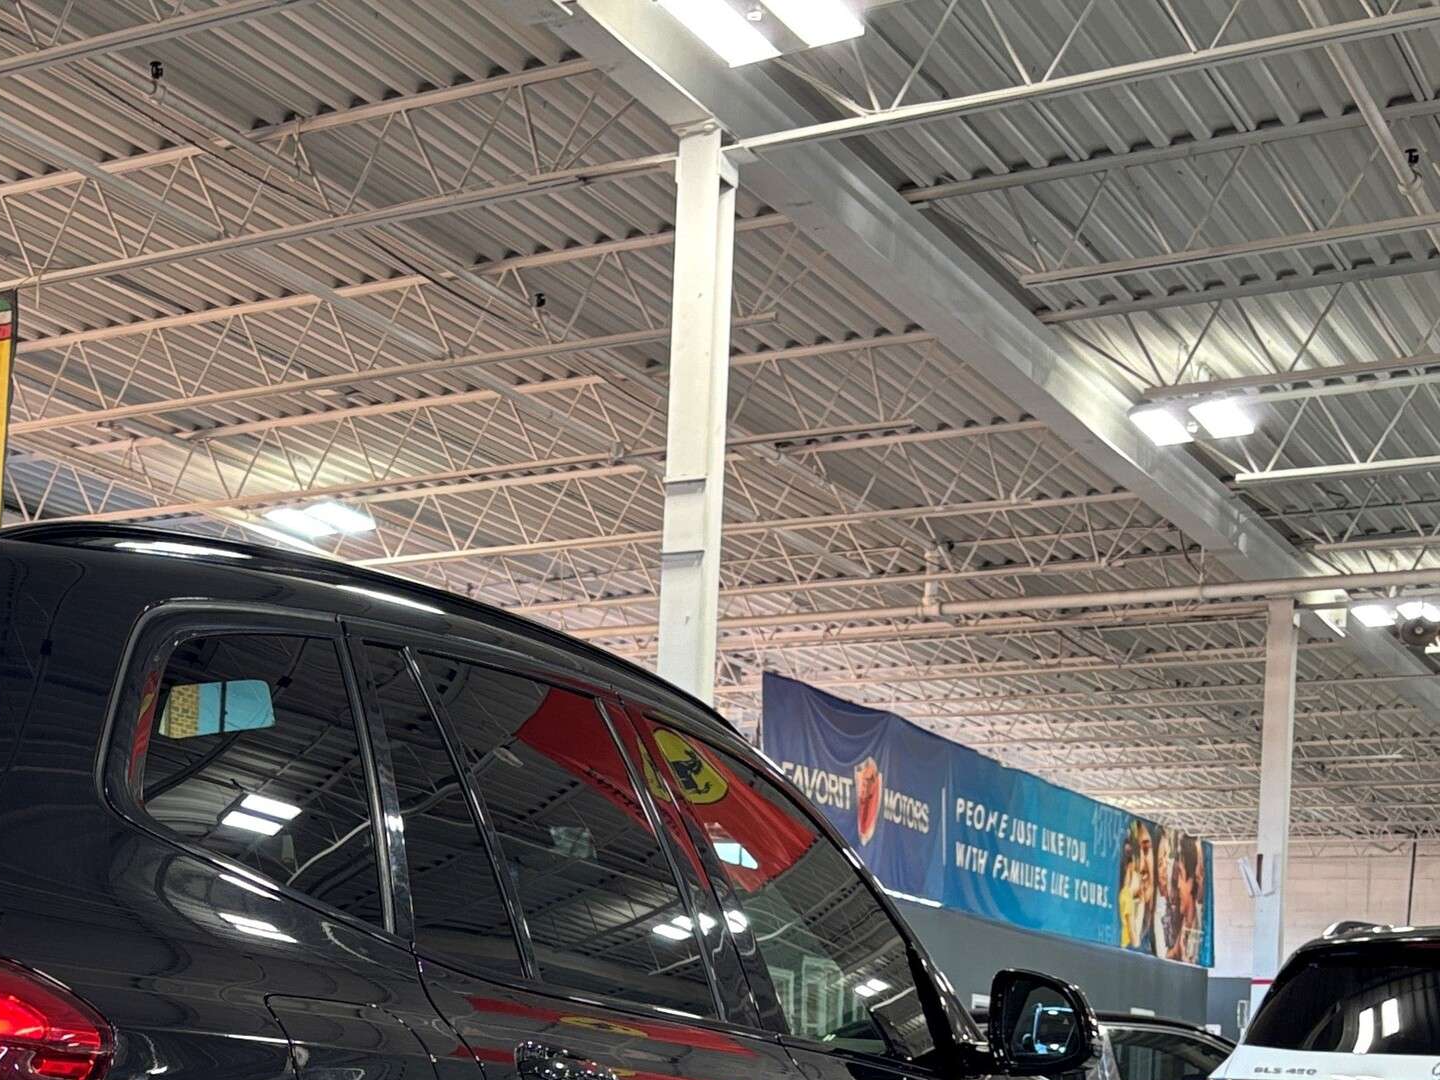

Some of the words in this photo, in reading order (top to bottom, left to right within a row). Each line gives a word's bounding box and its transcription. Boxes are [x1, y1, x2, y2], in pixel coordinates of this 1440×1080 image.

[884, 788, 930, 834] MOTORS
[1010, 818, 1039, 848] JUST
[956, 842, 988, 874] WITH
[993, 855, 1047, 892] FAMILIES
